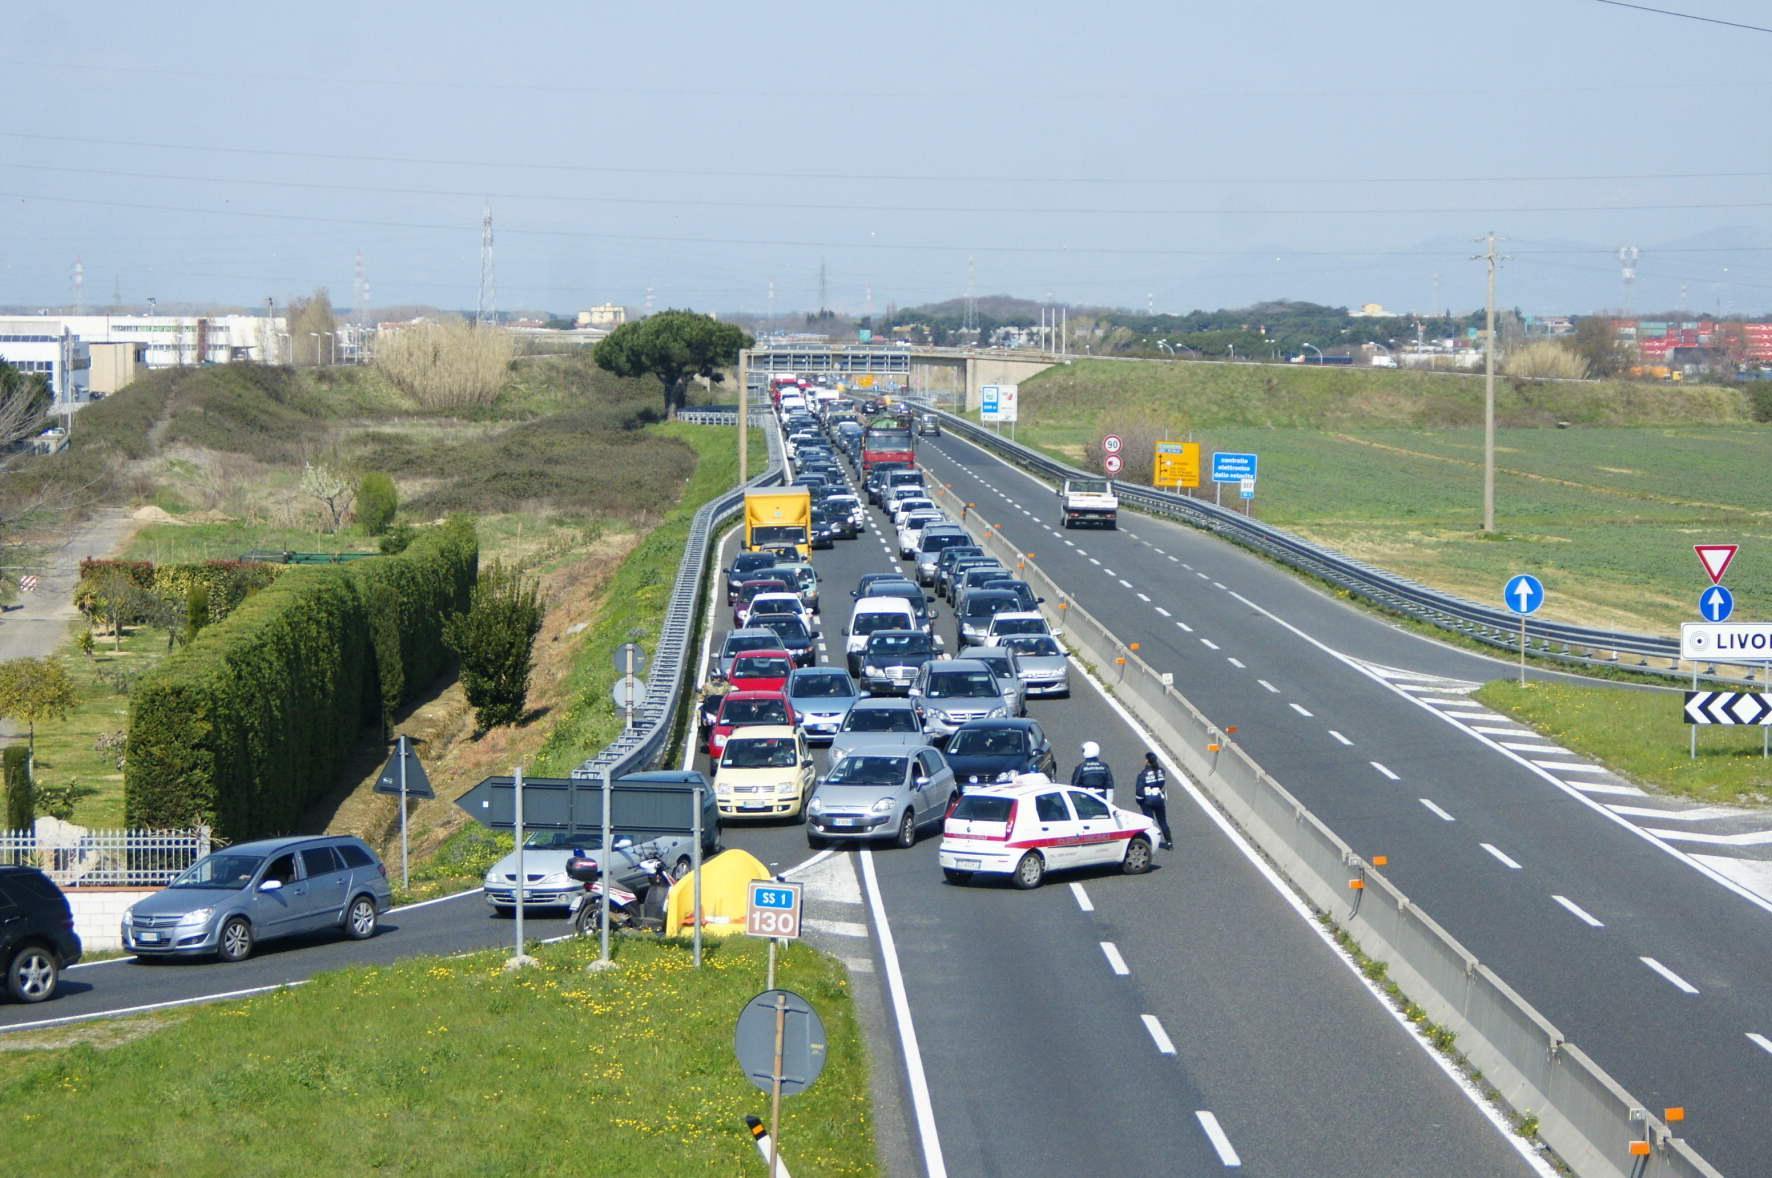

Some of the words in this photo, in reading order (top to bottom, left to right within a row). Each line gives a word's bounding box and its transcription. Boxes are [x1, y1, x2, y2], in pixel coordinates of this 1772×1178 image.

[1107, 440, 1118, 449] 90
[1717, 633, 1772, 649] LIVO
[762, 892, 776, 905] SS
[780, 893, 787, 905] 1
[752, 910, 794, 933] 130
